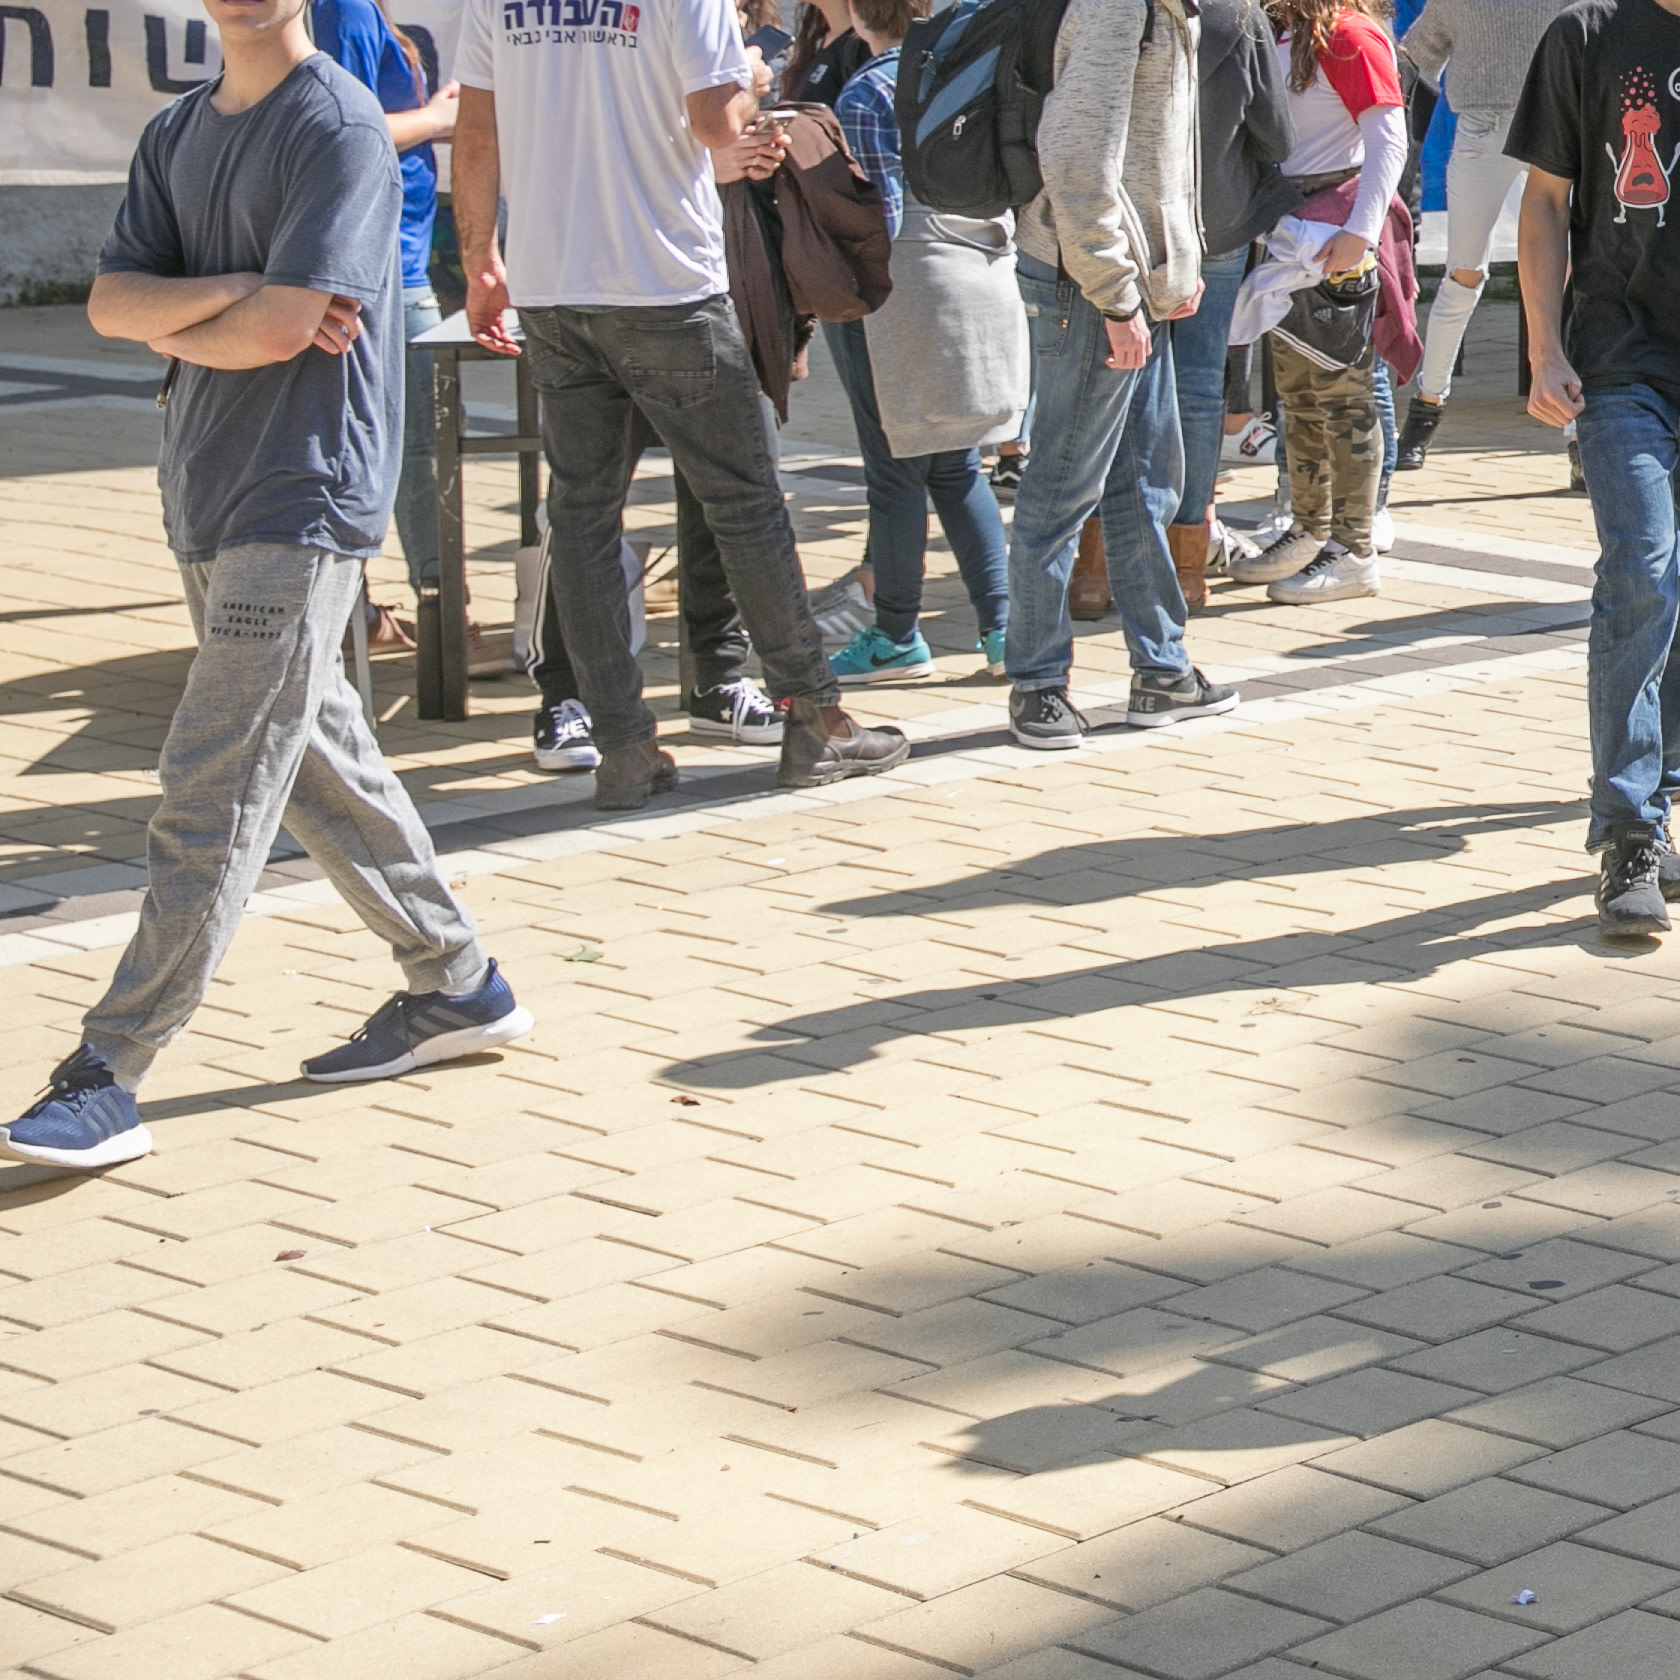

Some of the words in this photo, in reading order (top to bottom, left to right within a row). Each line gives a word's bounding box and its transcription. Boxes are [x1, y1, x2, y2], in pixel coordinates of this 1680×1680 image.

[504, 0, 624, 31] העבודה
[546, 30, 576, 44] אבי
[222, 602, 285, 614] AMERICAN
[228, 615, 268, 627] EAGLE
